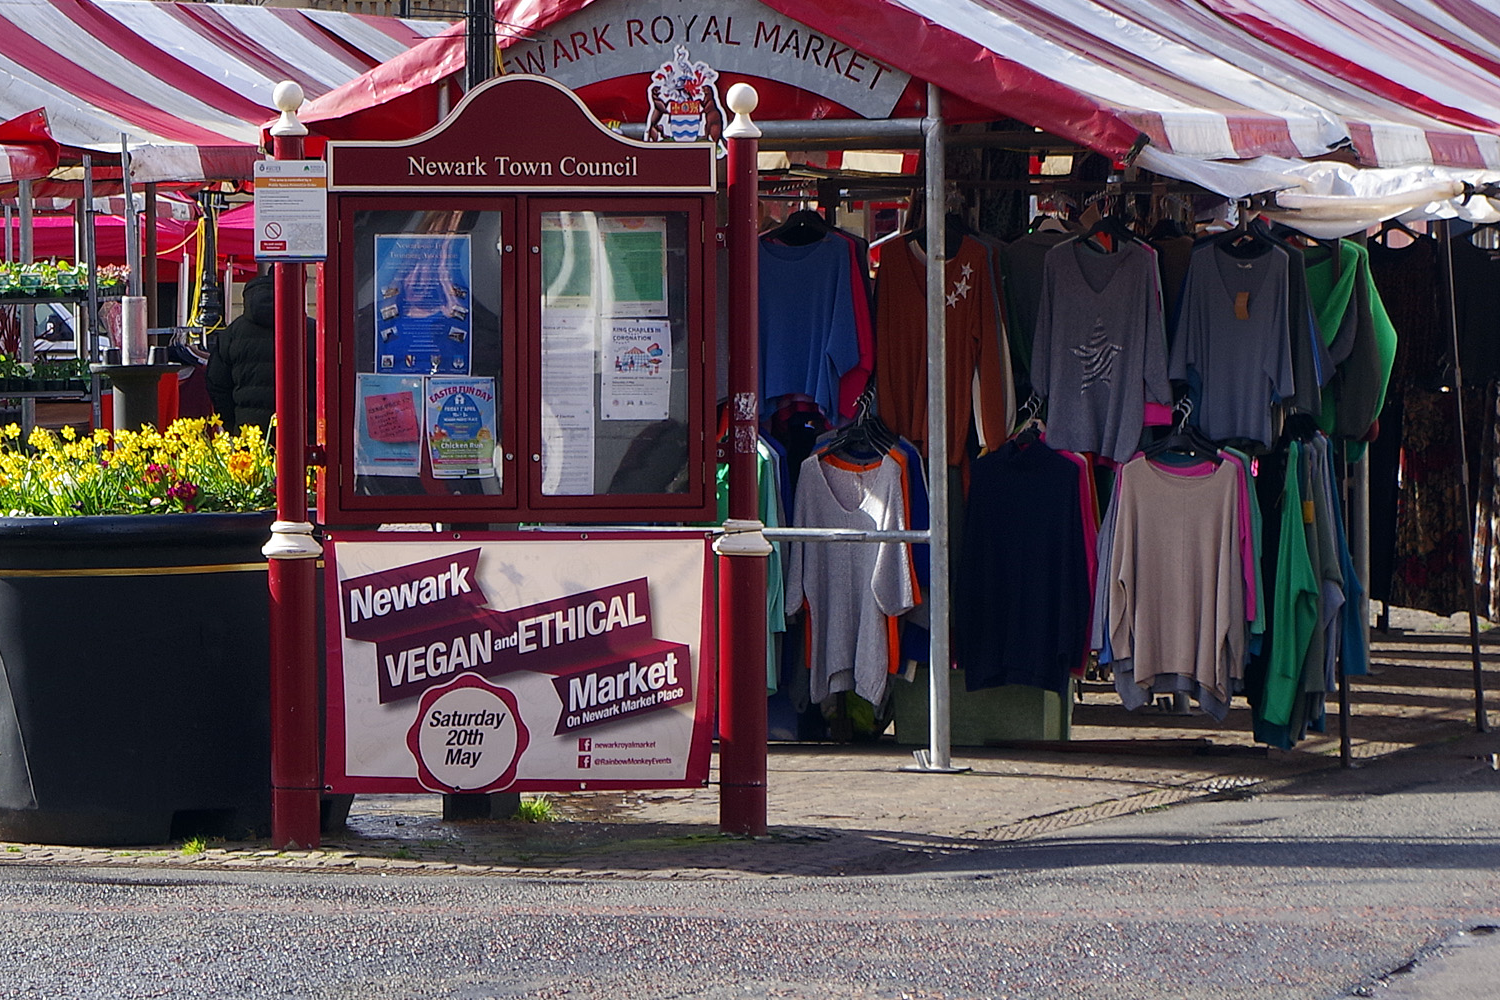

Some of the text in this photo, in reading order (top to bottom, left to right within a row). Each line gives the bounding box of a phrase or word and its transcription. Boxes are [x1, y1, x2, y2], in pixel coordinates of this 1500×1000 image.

[498, 14, 892, 90] WARK ROYAL MARKET
[408, 156, 638, 176] Newark Town Council
[430, 385, 493, 403] EASTER FUN DAY
[350, 562, 472, 623] Newark
[385, 592, 646, 687] VEGAN and ETHICAL
[569, 652, 678, 712] Market
[566, 687, 684, 728] On Newark Market Place
[429, 709, 506, 730] Saturday
[445, 728, 484, 746] 20th
[595, 741, 656, 750] newarkroyalmarket
[445, 748, 482, 769] May
[594, 757, 672, 767] @RainbowMonkeyEvents
